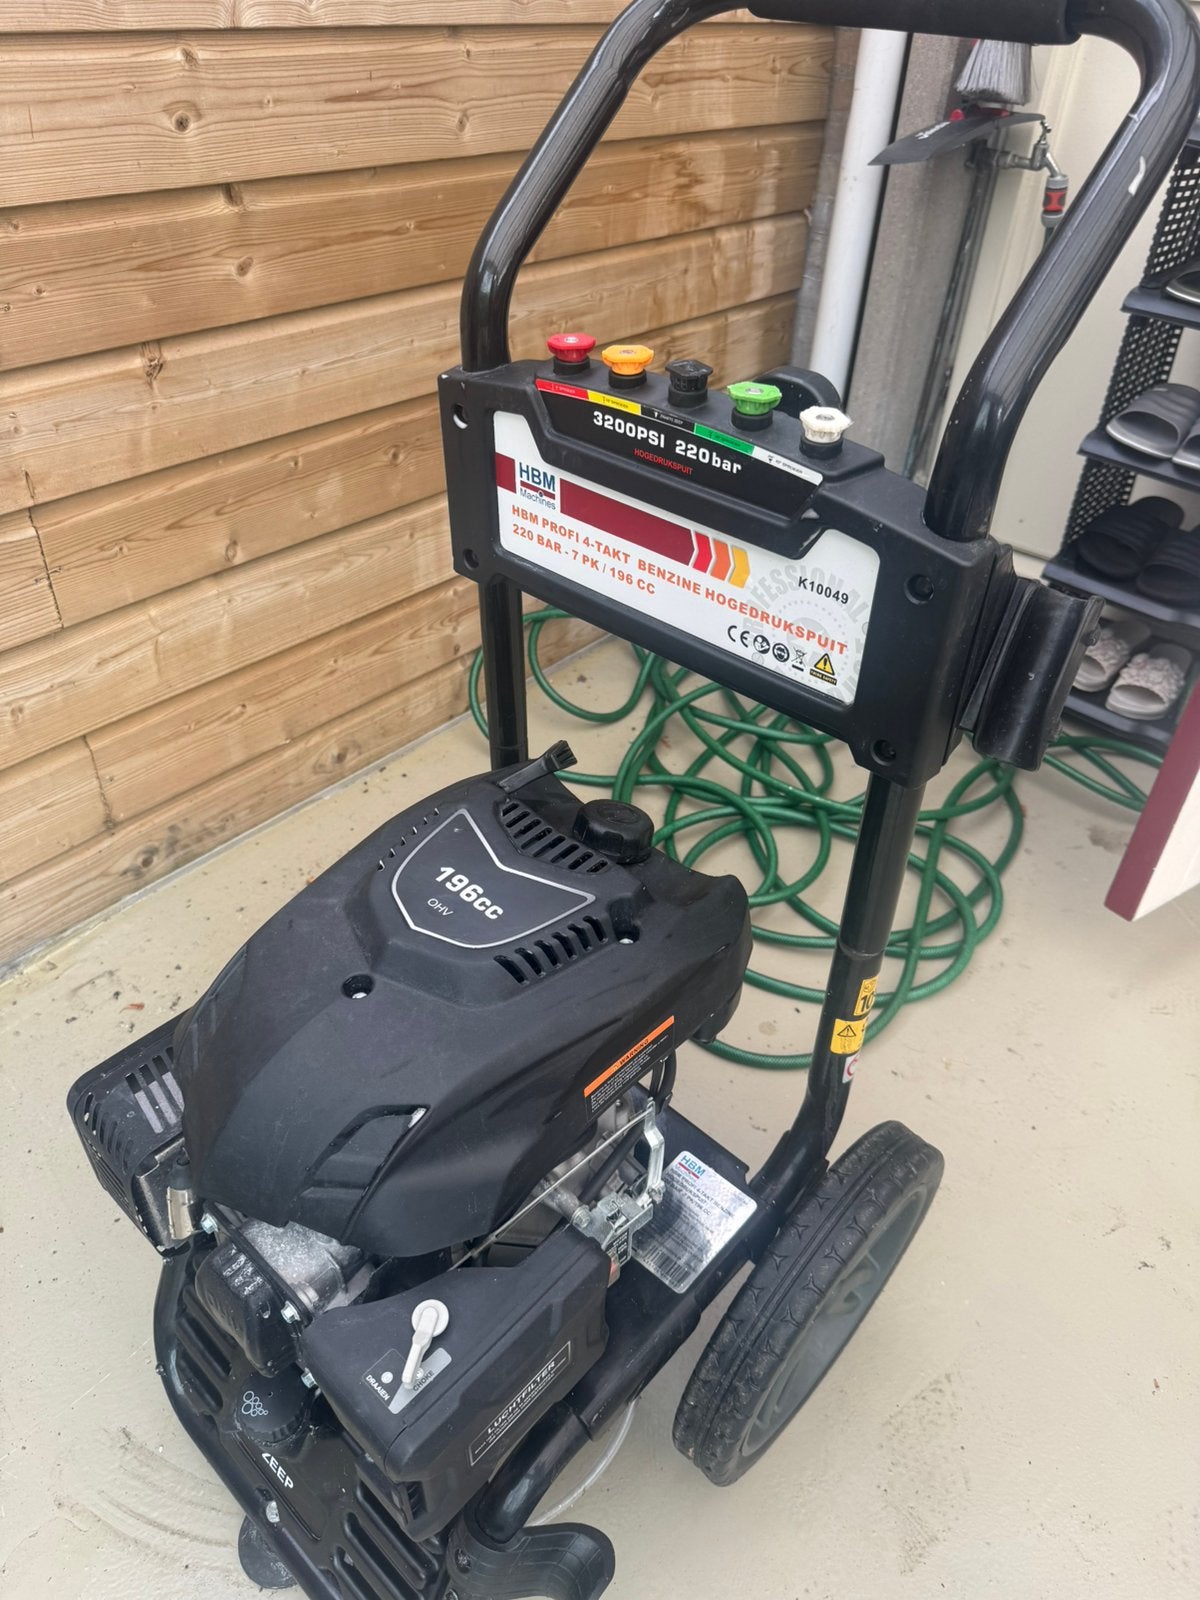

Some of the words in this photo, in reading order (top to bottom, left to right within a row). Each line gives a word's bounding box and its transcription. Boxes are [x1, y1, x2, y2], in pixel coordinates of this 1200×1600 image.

[593, 410, 665, 448] 3200PSI
[675, 440, 742, 474] 220bar
[634, 448, 694, 475] HOGEDRUKSPUIT
[519, 462, 556, 493] HBM
[520, 488, 556, 510] Machines
[513, 523, 534, 541] 220
[537, 533, 562, 555] BAR
[572, 549, 578, 561] 7
[582, 554, 599, 573] PK
[602, 563, 607, 574] /
[609, 567, 633, 585] 196
[637, 578, 656, 595] CC
[512, 504, 539, 525] HBM
[542, 517, 580, 543] PROFI
[582, 536, 631, 564] 4-TAKT
[638, 558, 701, 595] BENZINE
[705, 587, 848, 655] HOGEDRUKSPUIT
[798, 576, 849, 605] K10049
[427, 898, 454, 916] OHV
[435, 866, 504, 920] 196cc
[619, 1038, 649, 1066] WARNING
[680, 1154, 706, 1177] HBM
[366, 1374, 390, 1401] DRAAIEN
[413, 1370, 435, 1392] CHOKE
[487, 1360, 556, 1434] LUCHTFILTER
